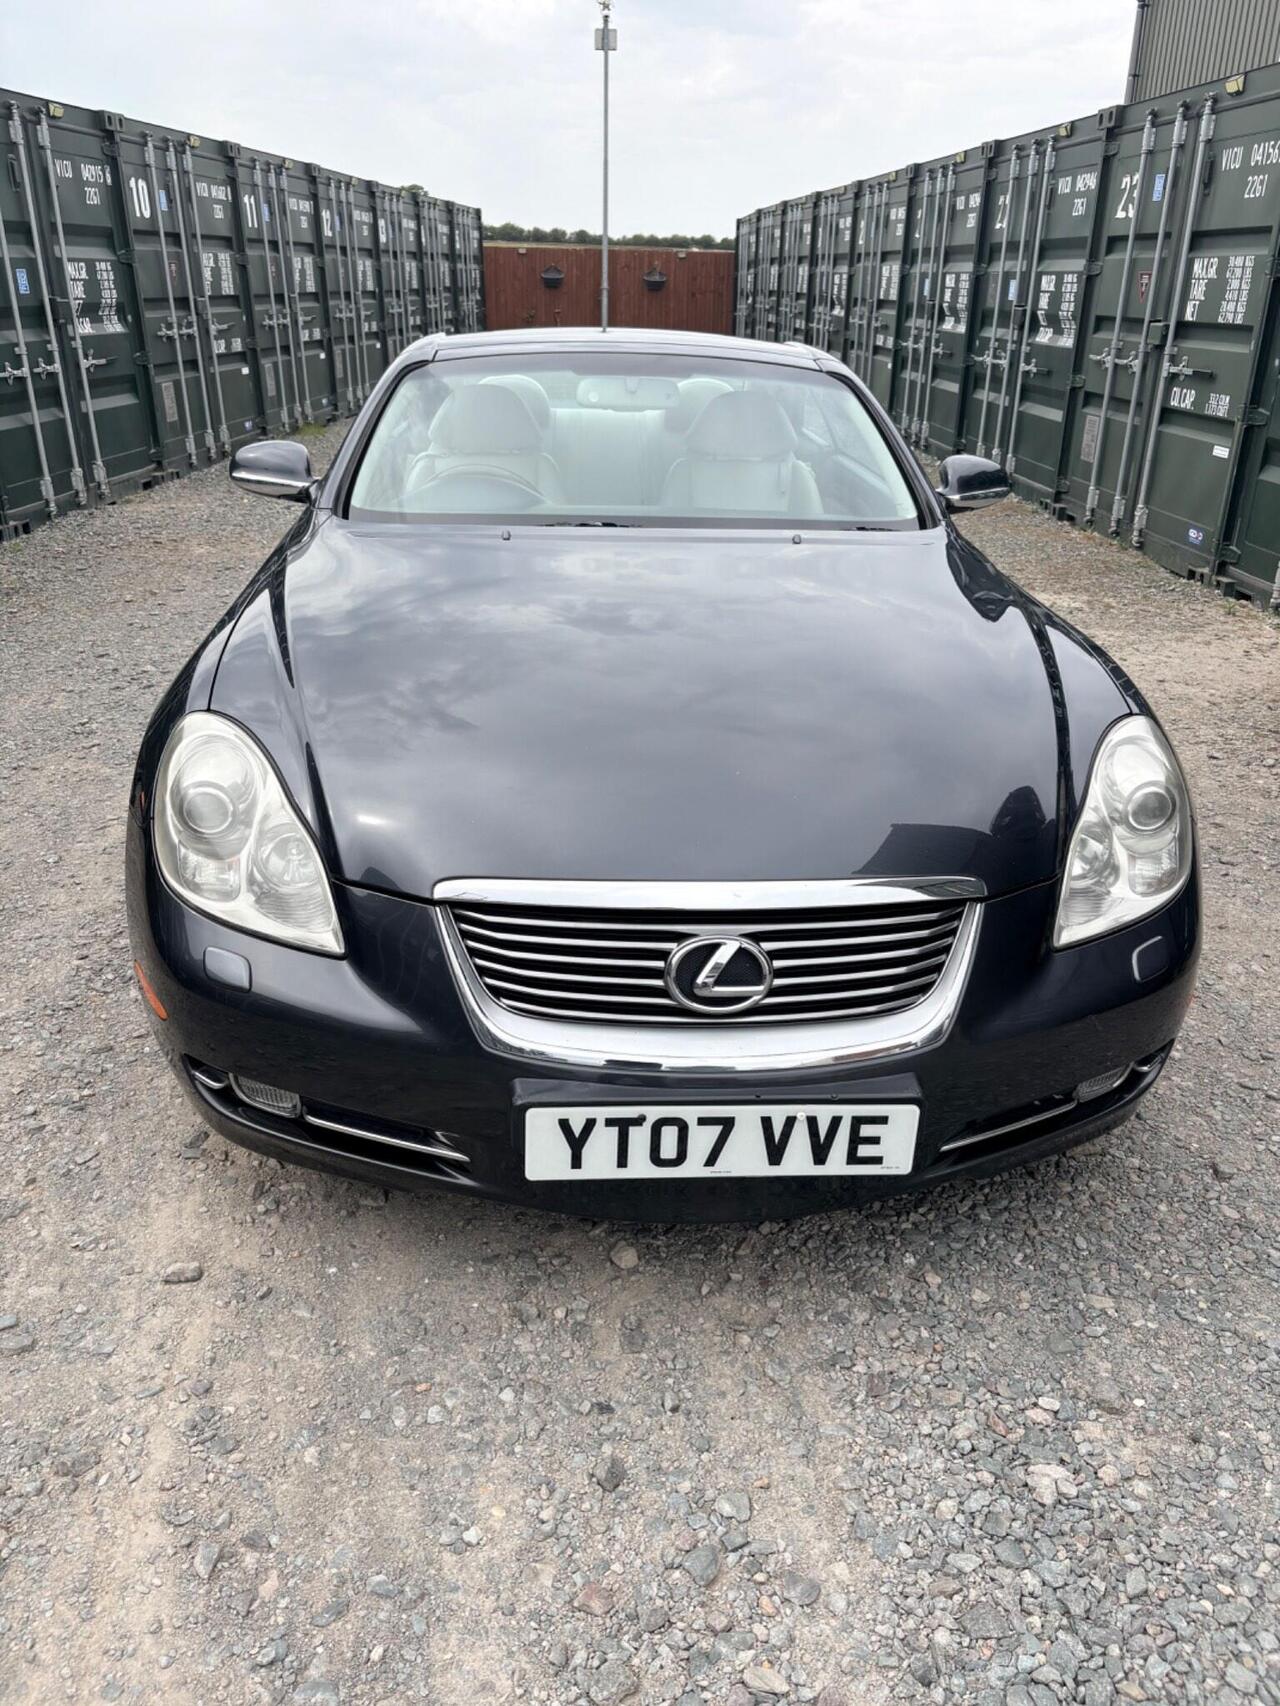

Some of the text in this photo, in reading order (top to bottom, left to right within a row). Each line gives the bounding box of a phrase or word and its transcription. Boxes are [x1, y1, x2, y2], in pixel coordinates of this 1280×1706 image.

[54, 158, 73, 178] VICU
[1222, 140, 1280, 171] VICU 04156
[84, 187, 101, 205] 22G1
[129, 177, 151, 219] 10
[1244, 174, 1268, 198] 22G1
[243, 194, 258, 229] 11
[321, 209, 333, 237] 12
[1189, 279, 1209, 300] TARE
[1184, 301, 1200, 321] NET
[557, 1115, 890, 1170] YT07 VVE
